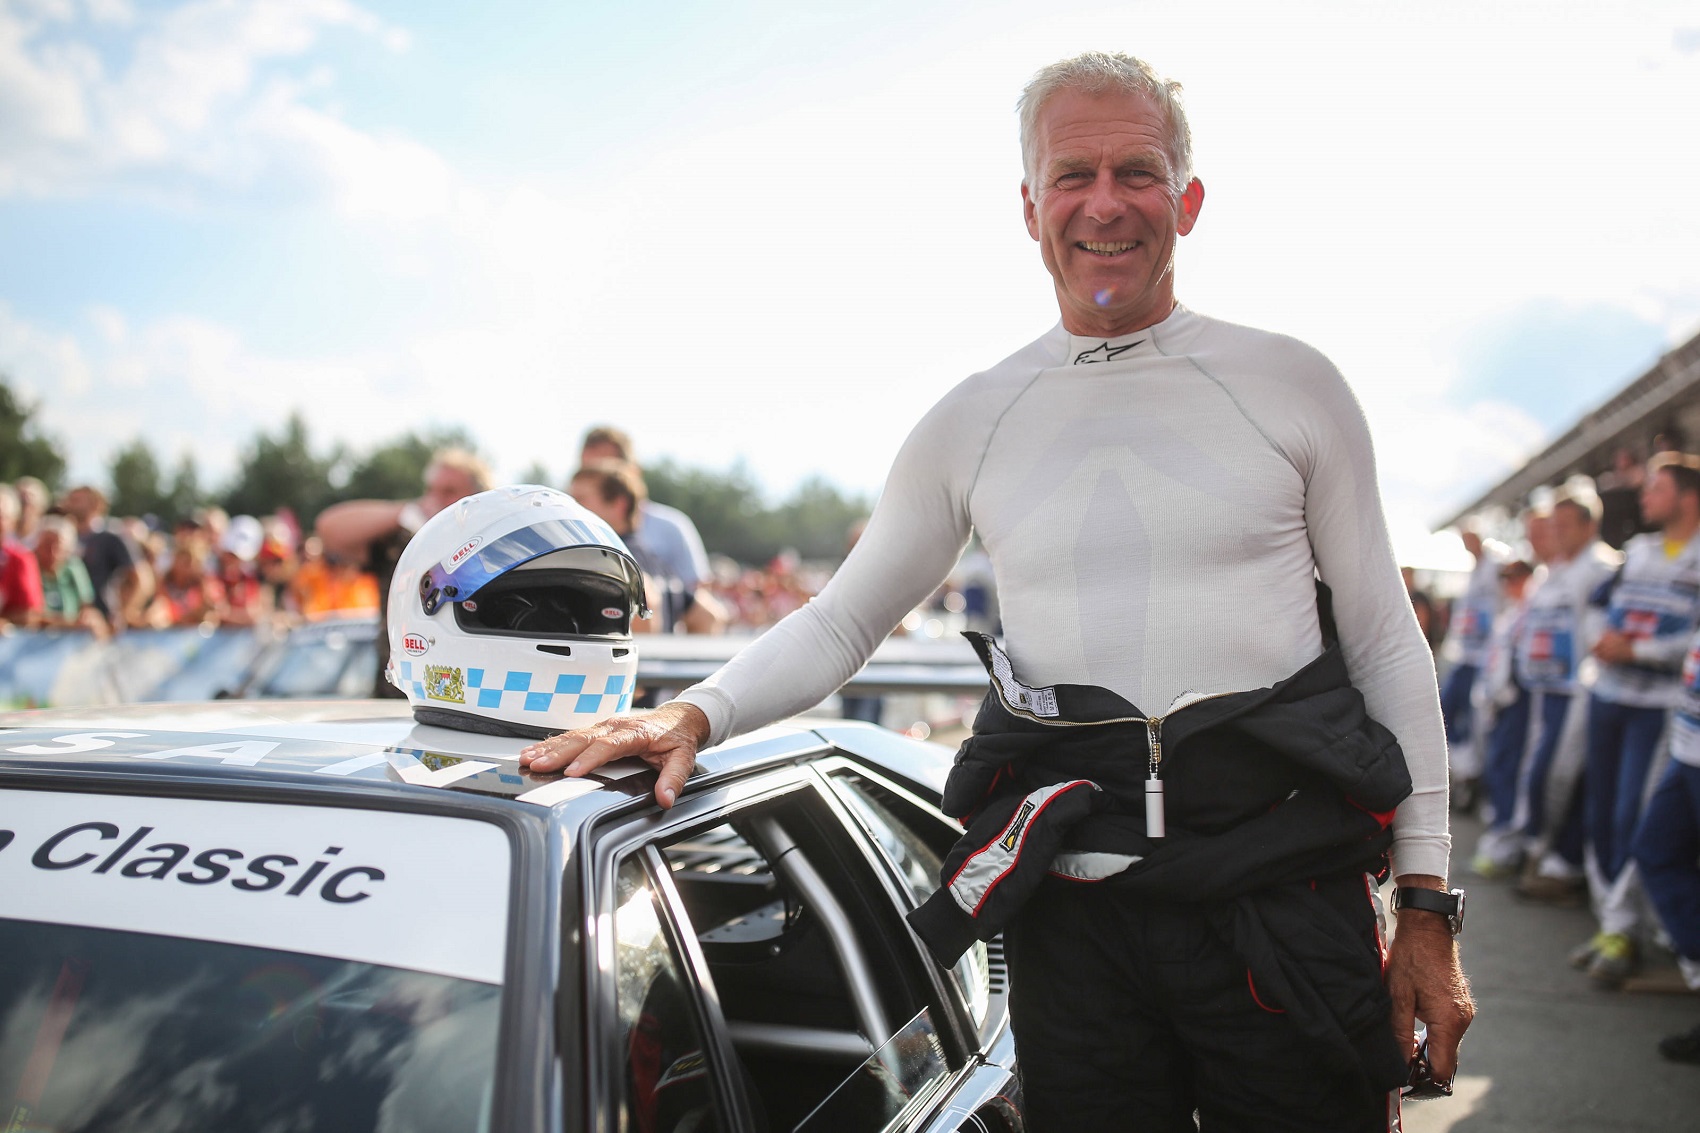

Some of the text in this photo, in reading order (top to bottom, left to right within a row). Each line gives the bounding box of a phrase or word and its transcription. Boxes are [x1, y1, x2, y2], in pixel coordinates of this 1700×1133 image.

[452, 542, 475, 562] BELL
[404, 638, 425, 650] BELL
[31, 821, 386, 904] Classic
